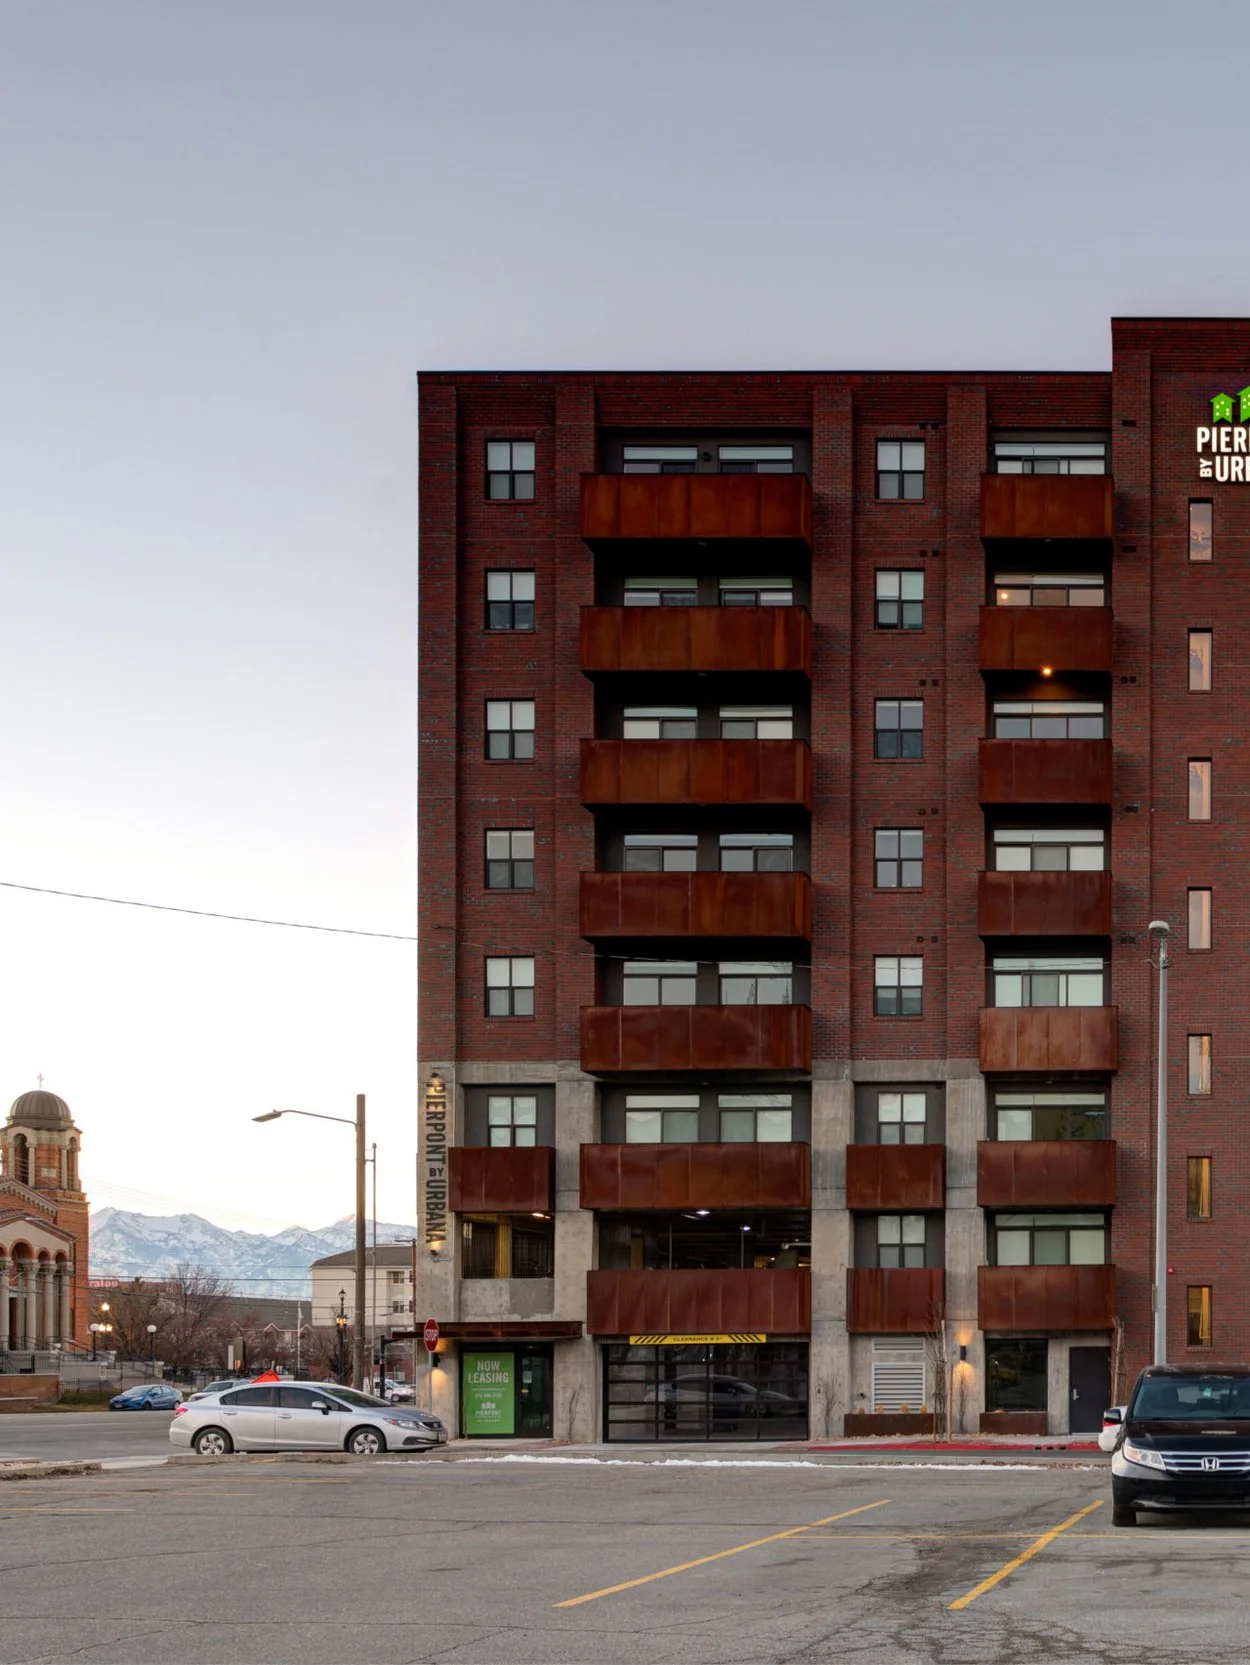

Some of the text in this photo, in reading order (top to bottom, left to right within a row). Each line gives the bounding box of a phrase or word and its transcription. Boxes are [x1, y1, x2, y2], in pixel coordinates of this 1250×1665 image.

[1200, 458, 1212, 477] BY
[425, 1083, 447, 1243] PIERPONT BY URBANA
[425, 1329, 438, 1341] STOP
[477, 1360, 500, 1371] NOW
[468, 1372, 509, 1384] LEASING
